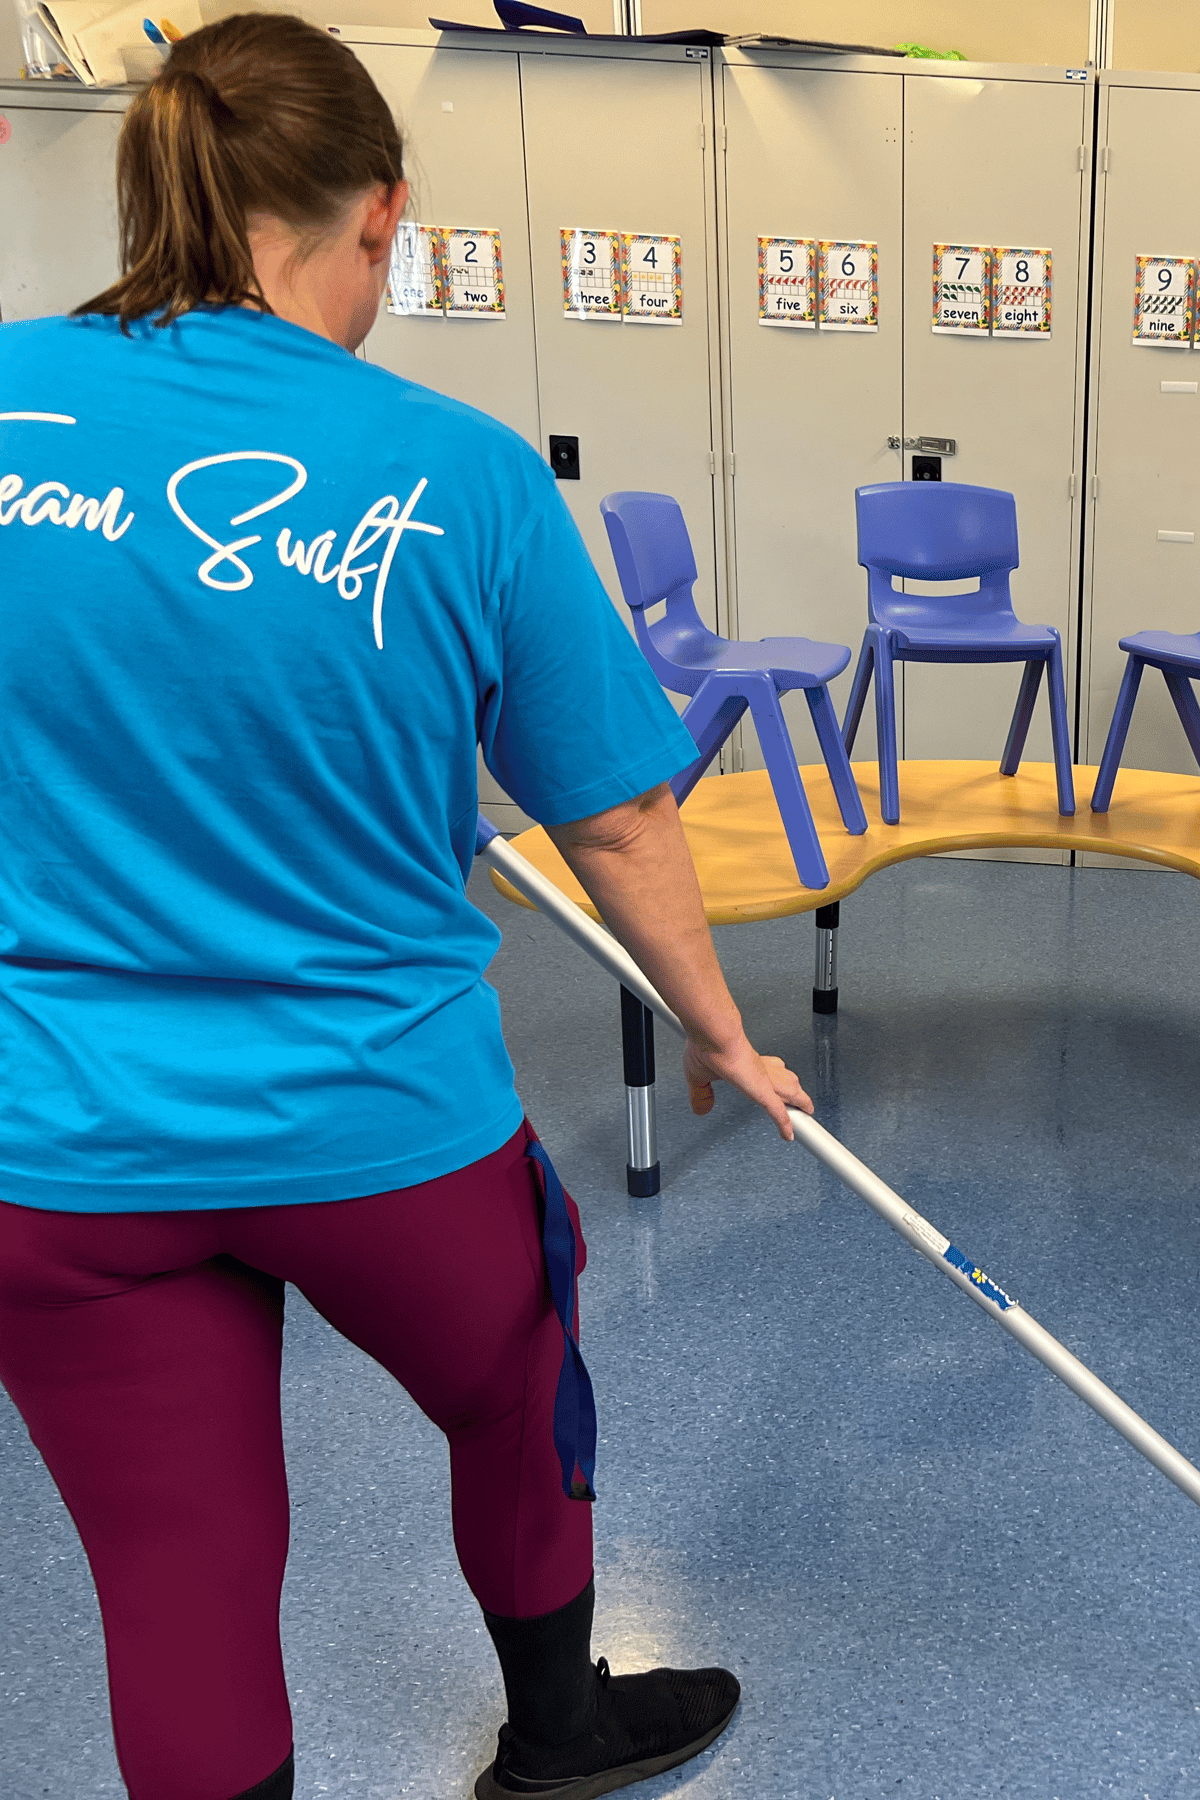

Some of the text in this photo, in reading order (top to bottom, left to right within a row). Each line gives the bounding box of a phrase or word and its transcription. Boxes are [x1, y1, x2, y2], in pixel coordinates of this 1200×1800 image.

[403, 235, 415, 259] 1
[463, 240, 478, 264] 2
[583, 241, 597, 264] 3
[642, 246, 659, 269] 4
[779, 249, 794, 273] 5
[841, 253, 856, 276] 6
[954, 257, 971, 280] 7
[1015, 259, 1030, 283] 8
[1157, 268, 1173, 292] 9
[403, 287, 424, 299] one
[464, 290, 488, 303] two
[575, 291, 611, 306] three
[639, 294, 668, 308] four
[776, 298, 801, 312] five
[839, 302, 859, 316] six
[943, 309, 979, 322] seven
[1004, 309, 1039, 326] eight
[1149, 320, 1176, 333] nine
[0, 412, 446, 650] eam Swift
